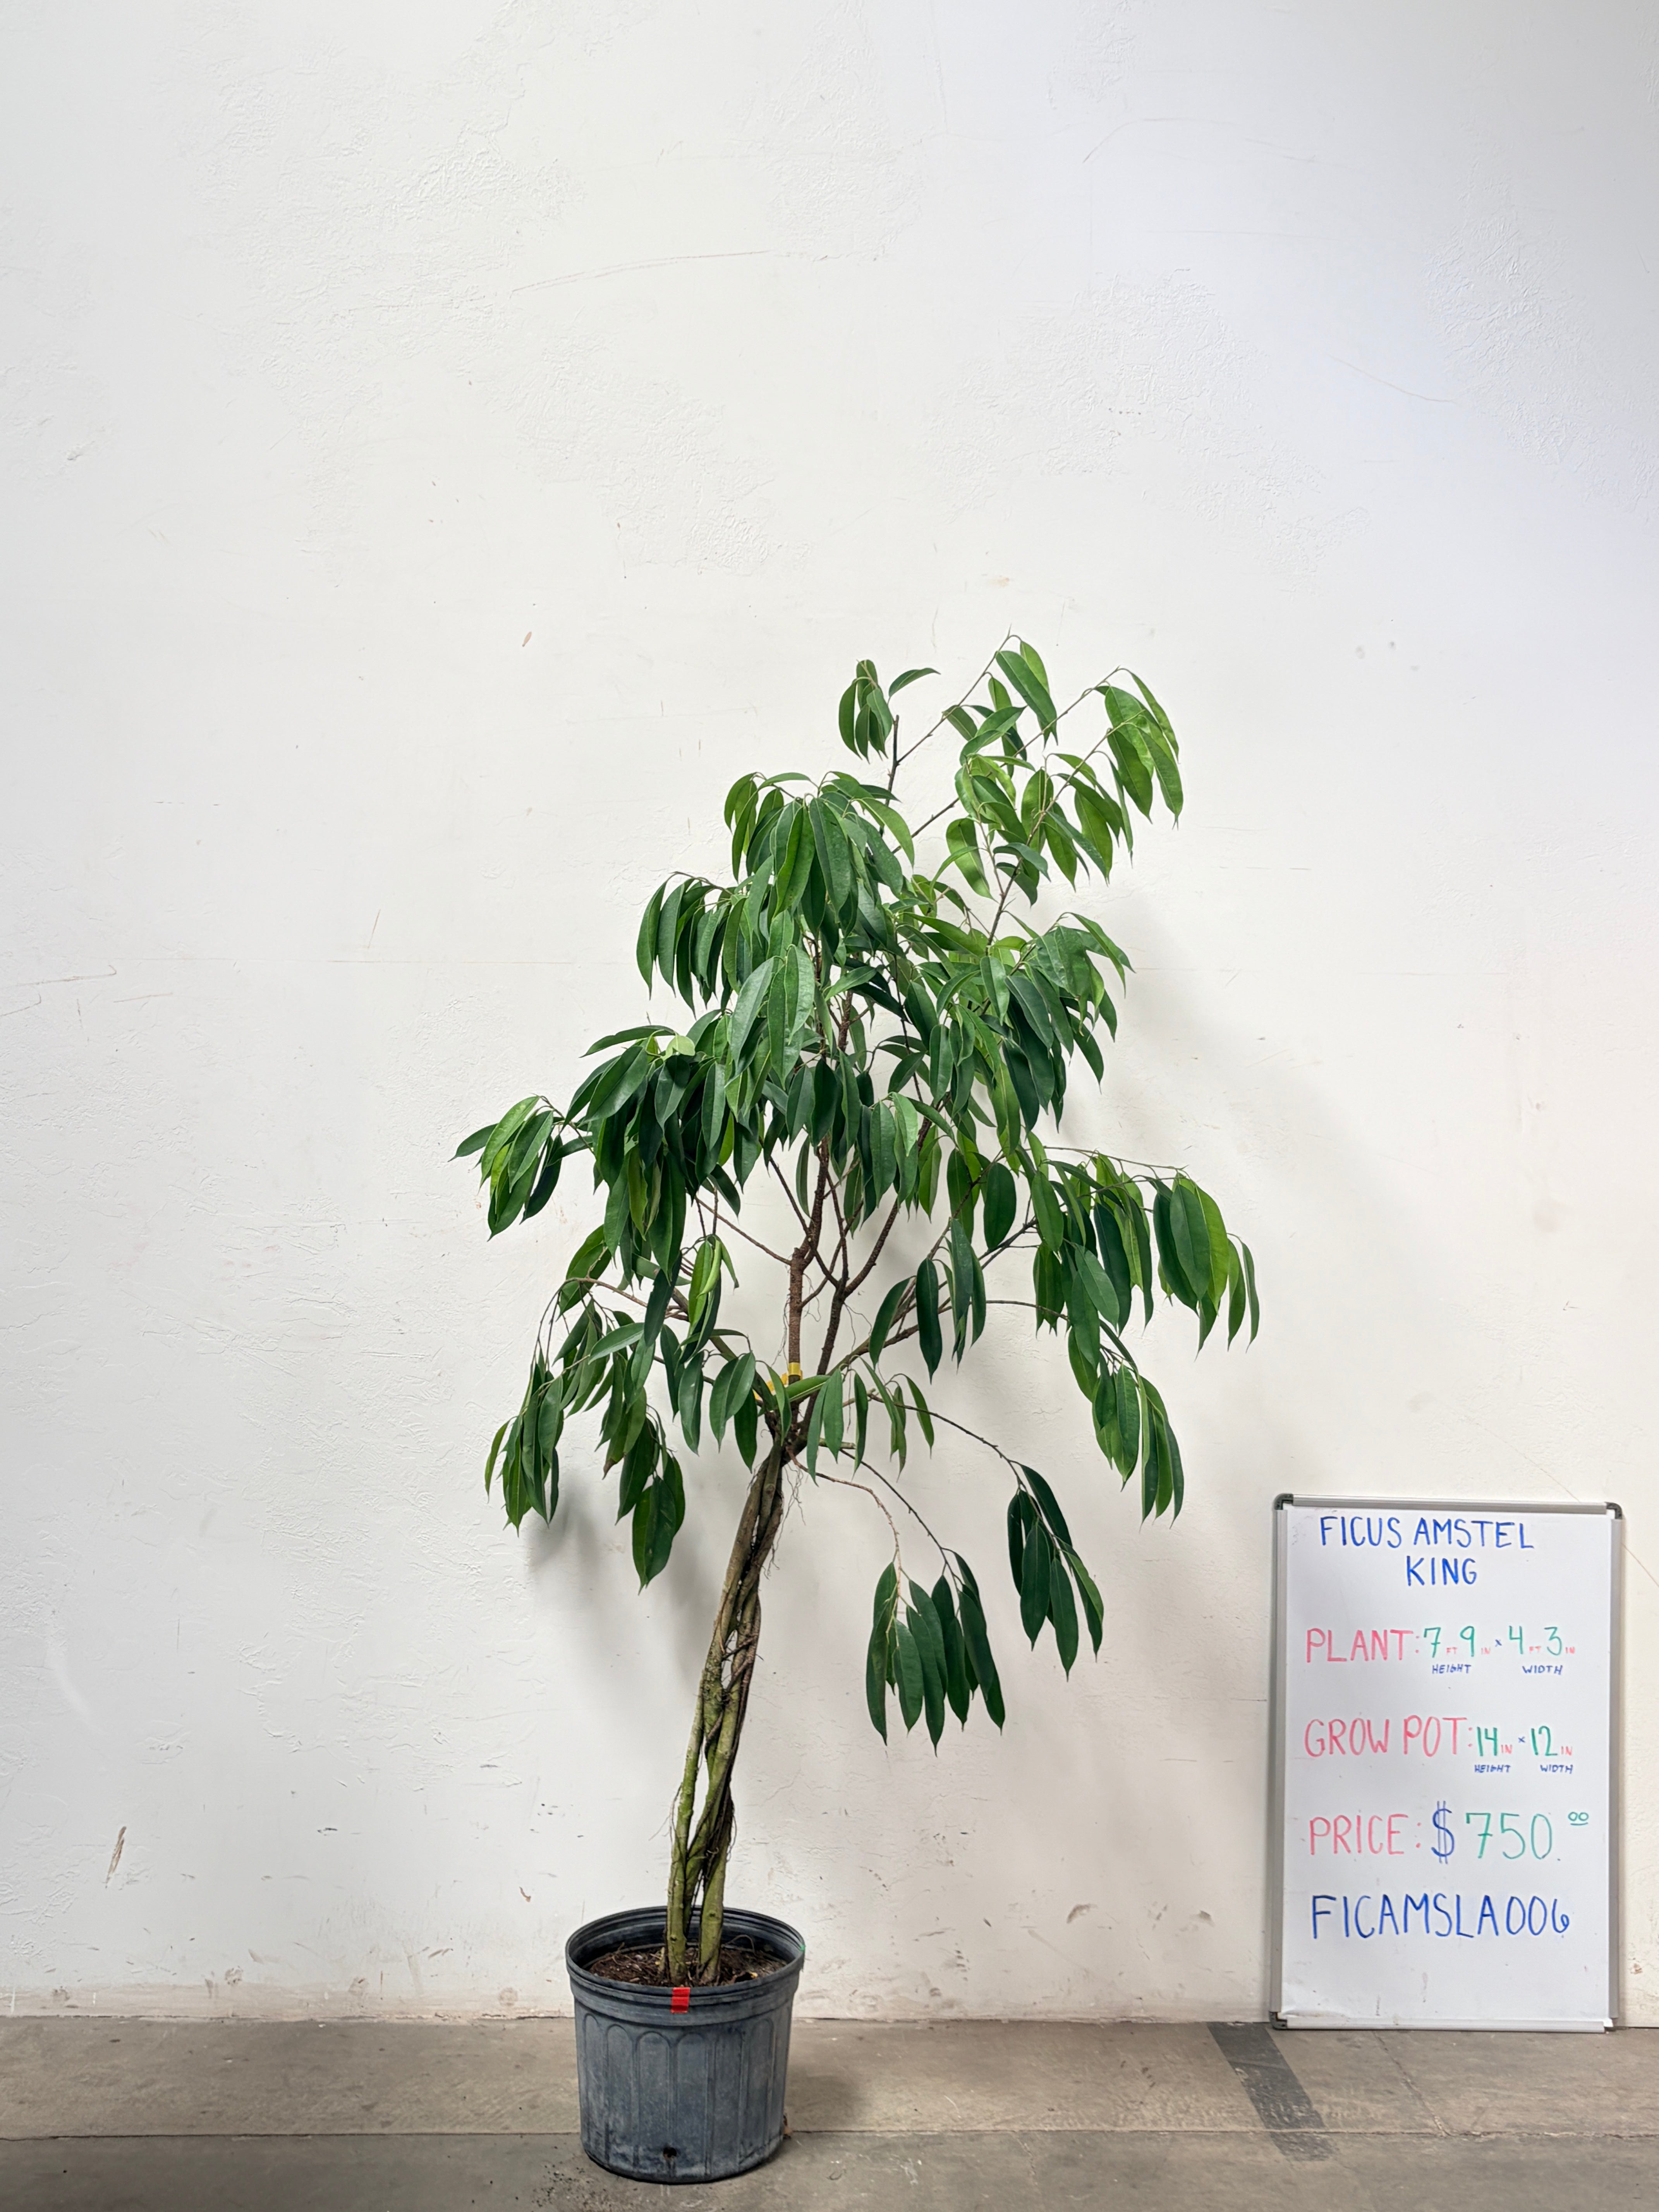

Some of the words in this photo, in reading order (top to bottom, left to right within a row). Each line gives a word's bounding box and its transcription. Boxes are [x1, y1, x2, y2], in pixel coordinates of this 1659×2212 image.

[1320, 1516, 1402, 1548] FICUS
[1413, 1517, 1534, 1549] AMSTEL
[1406, 1556, 1477, 1586] KING
[1306, 1628, 1419, 1663] PLANT:
[1424, 1627, 1441, 1658] 7
[1460, 1626, 1475, 1657] 9
[1509, 1625, 1523, 1655] 4
[1544, 1626, 1563, 1656] 3
[1432, 1664, 1472, 1674] HEIGHT
[1522, 1665, 1563, 1675] WIDTH
[1304, 1718, 1389, 1757] GROW
[1403, 1715, 1473, 1757] POT:
[1477, 1726, 1498, 1757] 14
[1501, 1744, 1513, 1754] IN
[1531, 1726, 1558, 1756] 12
[1561, 1746, 1573, 1756] IN
[1474, 1764, 1511, 1773] HEIGHT
[1540, 1764, 1573, 1774] WIDTH
[1309, 1814, 1421, 1855] PRICE:
[1312, 1893, 1570, 1939] FICAMSLA006
